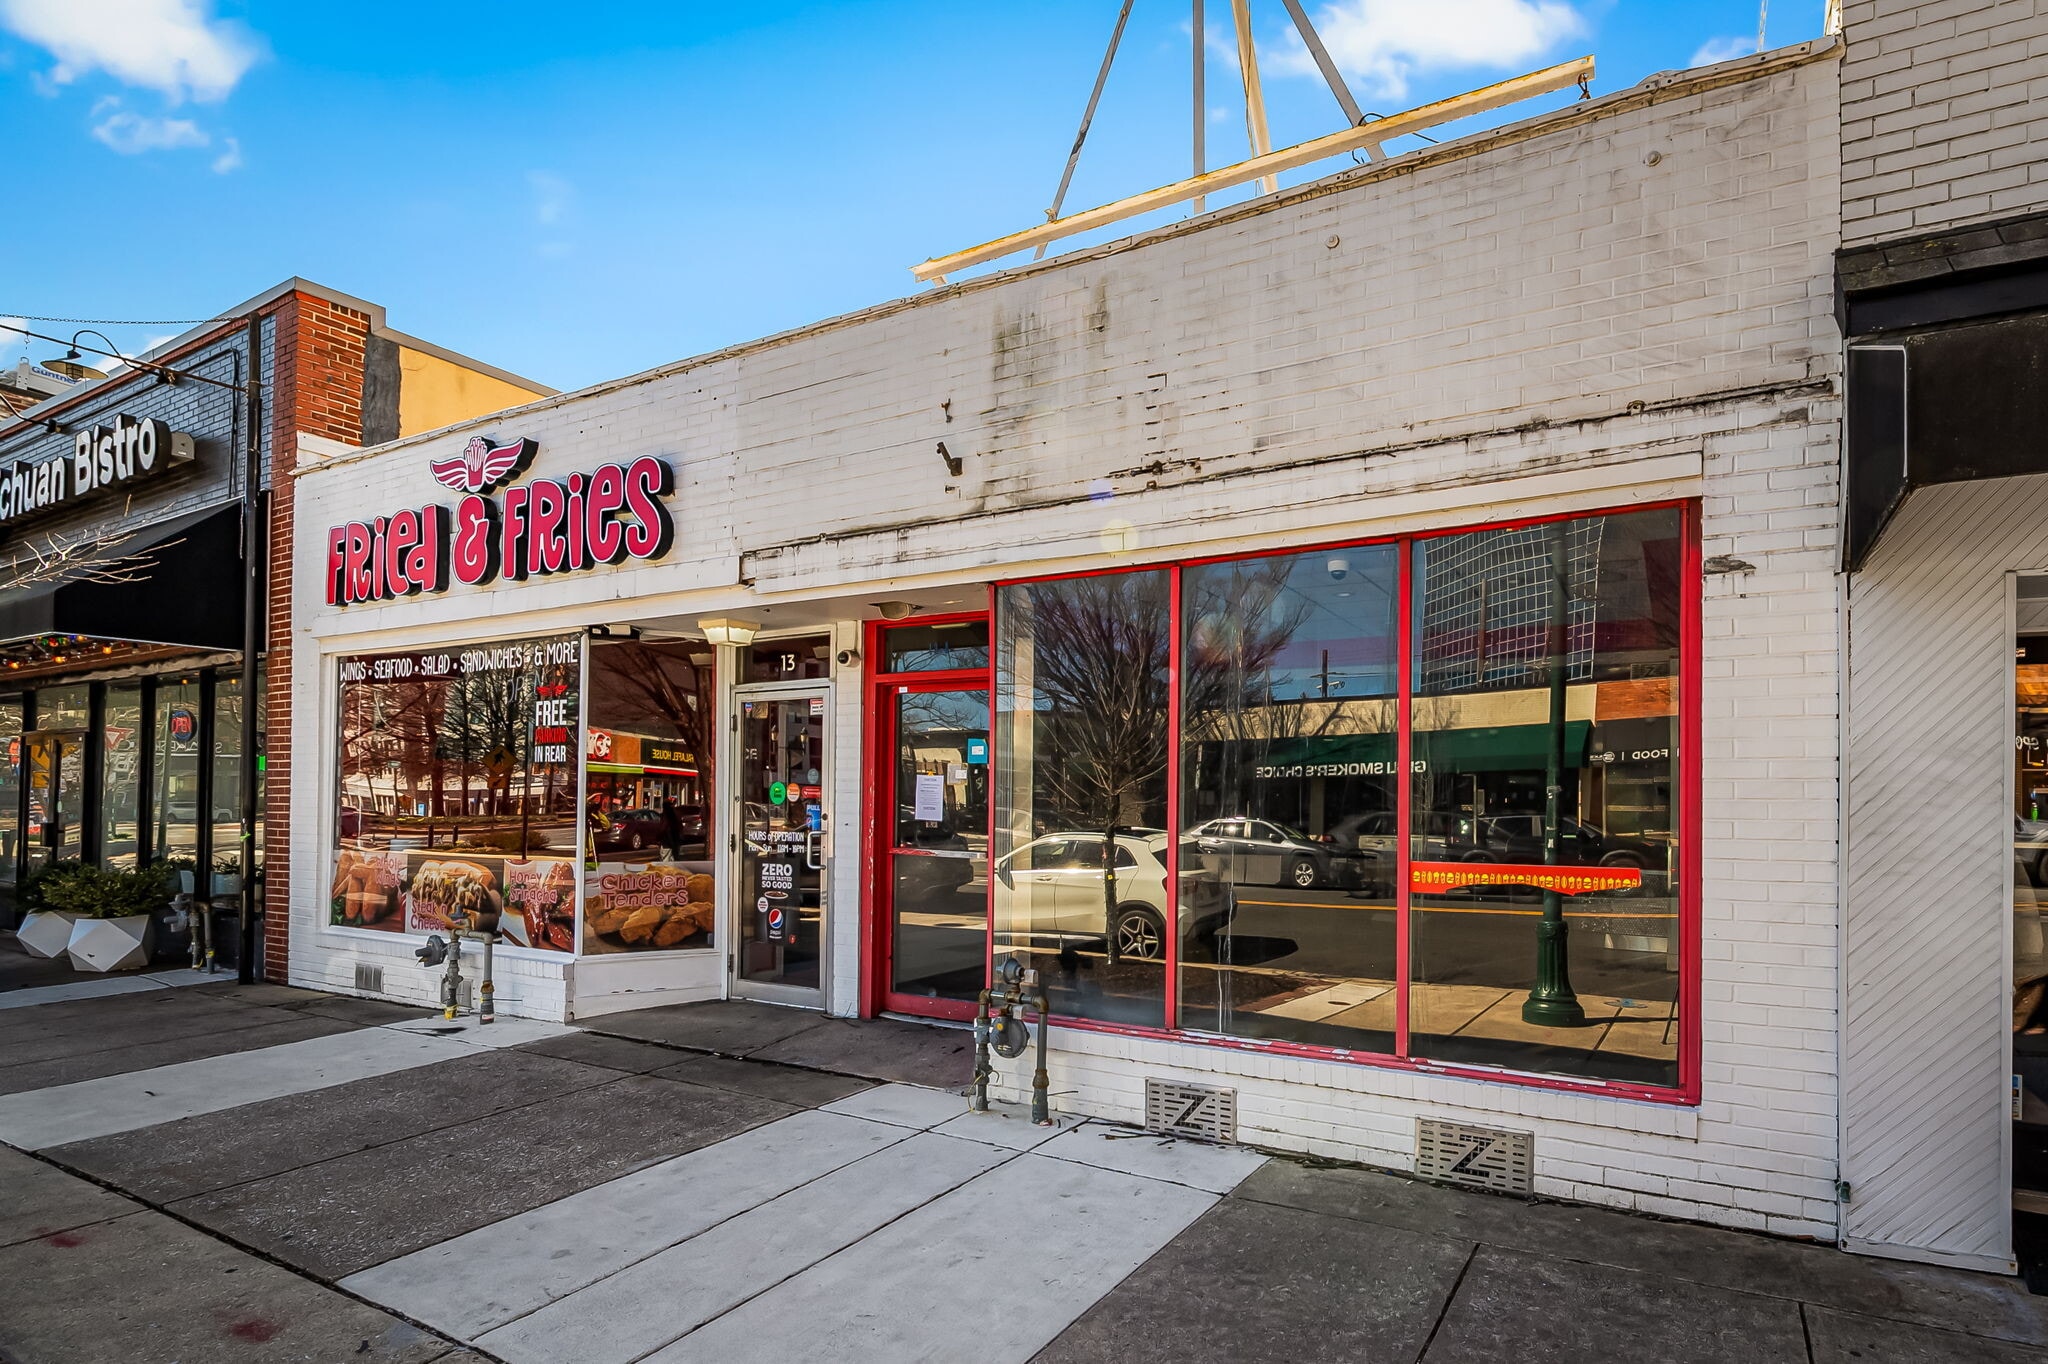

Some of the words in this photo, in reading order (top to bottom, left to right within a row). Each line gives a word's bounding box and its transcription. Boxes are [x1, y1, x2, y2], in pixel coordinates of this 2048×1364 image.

[75, 413, 156, 495] Bistro
[452, 495, 490, 585] &
[340, 661, 367, 681] WINGS
[374, 657, 412, 679] SEAFOOD
[421, 655, 450, 675] SALAD
[460, 647, 523, 673] SANDWICHES
[534, 651, 543, 666] &
[547, 641, 579, 664] MORE
[781, 653, 796, 671] 13
[535, 699, 568, 726] FREE
[172, 716, 192, 734] OPEN
[534, 745, 543, 763] IN
[544, 745, 567, 762] REAR
[748, 831, 767, 841] HOURS
[509, 869, 542, 884] Honey
[762, 864, 792, 876] ZERO
[600, 874, 687, 890] Chicken
[772, 881, 792, 889] GOOD
[509, 886, 558, 904] Sriracha
[411, 900, 438, 916] Steak
[410, 913, 446, 931] Cheese
